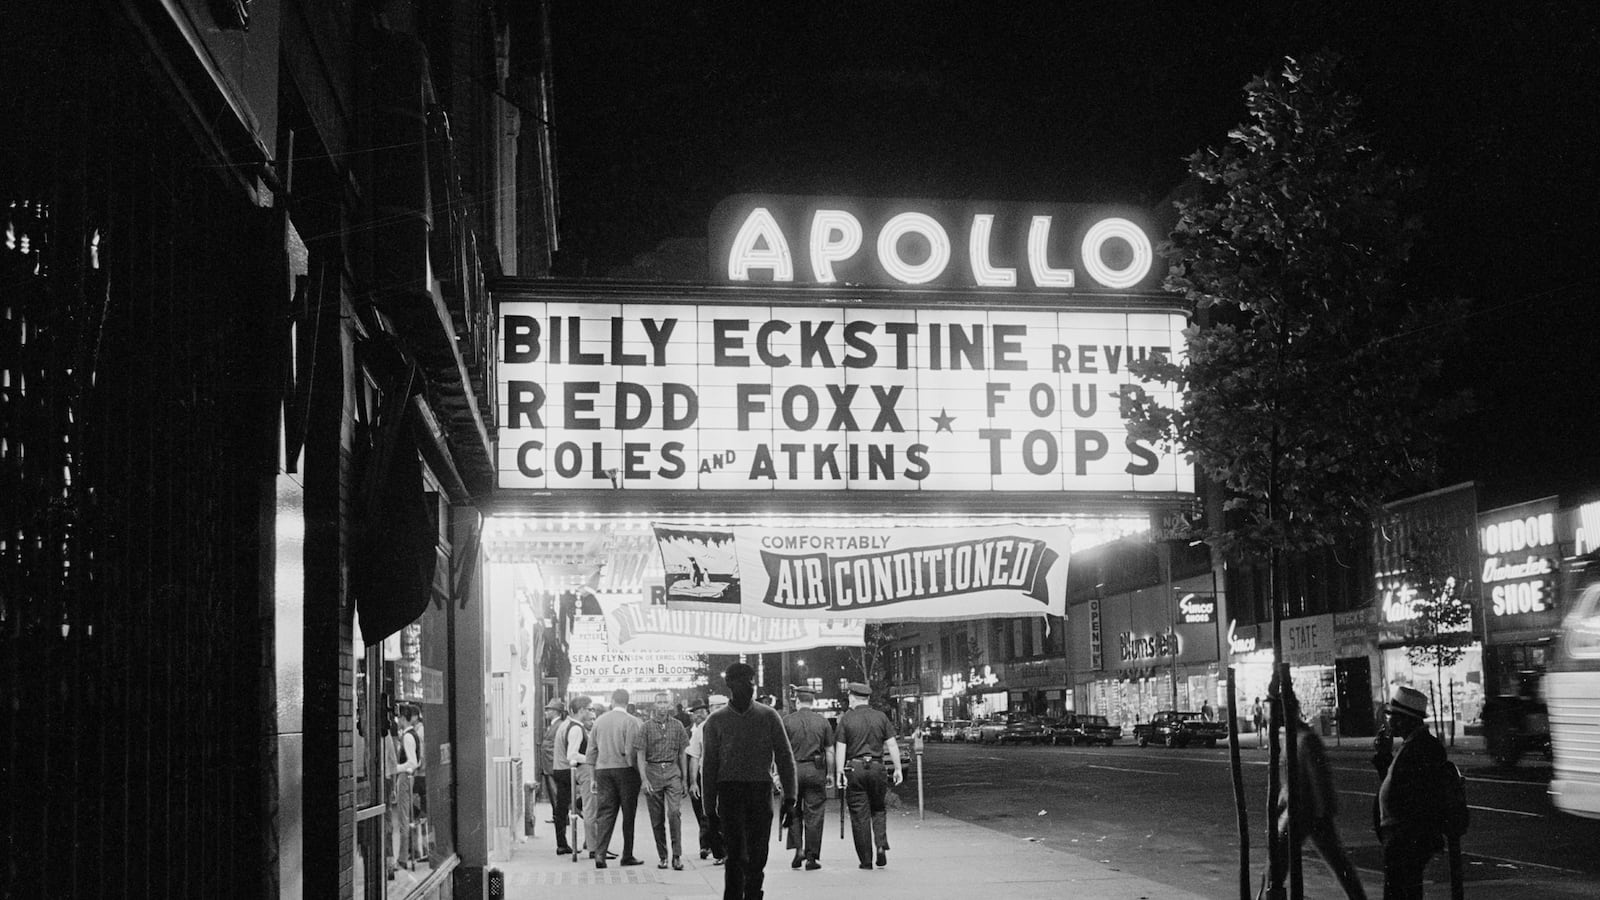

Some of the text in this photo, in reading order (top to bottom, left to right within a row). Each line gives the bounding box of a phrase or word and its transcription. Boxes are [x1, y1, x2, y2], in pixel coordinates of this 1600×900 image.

[727, 207, 1153, 289] APOLLO
[503, 315, 677, 366] BILLY
[713, 319, 1028, 370] ECKSTINE
[508, 380, 906, 433] REDD FOXX
[516, 440, 931, 481] COLES AND ATKINS
[979, 428, 1159, 476] TOPS
[762, 535, 892, 550] COMFORTABLY
[774, 540, 1032, 606] AIR CONDITIONED
[1492, 580, 1545, 616] SHOE
[1091, 601, 1099, 642] OPEN
[1289, 624, 1318, 650] STATE
[571, 654, 598, 663] SEAN
[601, 654, 631, 663] FLYNN
[575, 663, 688, 675] SON OF CAPTAIN BLOOD
